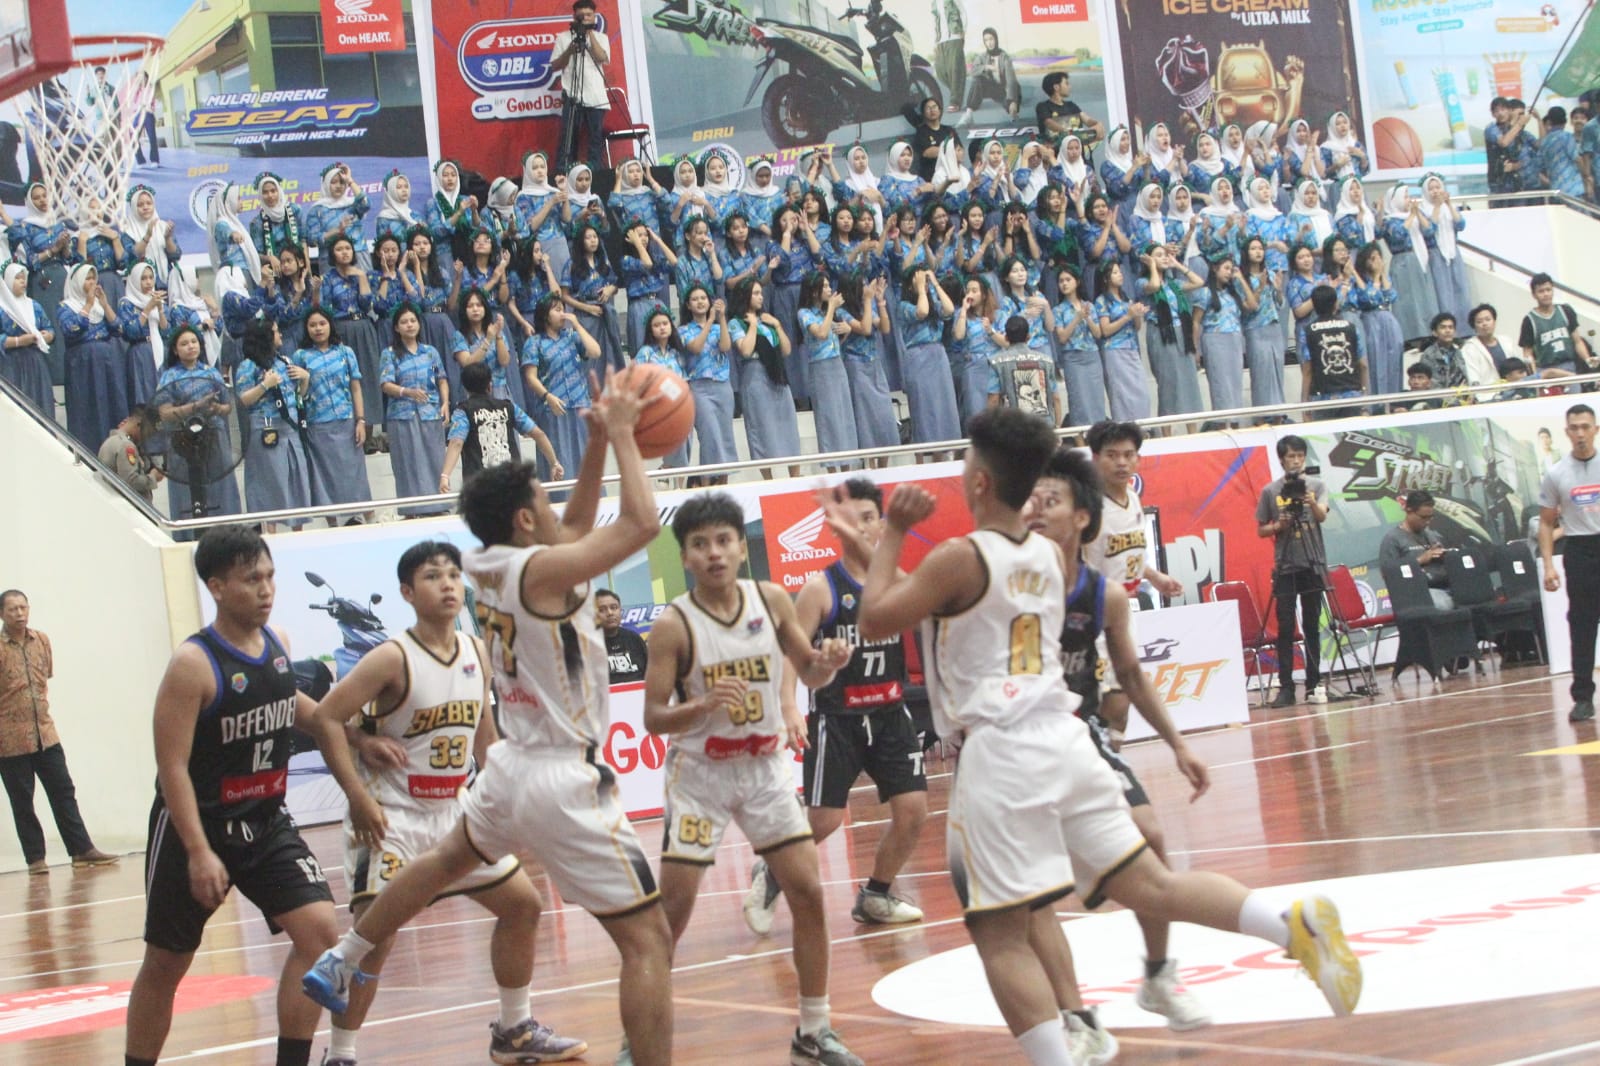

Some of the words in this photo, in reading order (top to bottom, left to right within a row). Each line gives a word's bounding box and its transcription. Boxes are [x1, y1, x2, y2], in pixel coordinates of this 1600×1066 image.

[336, 13, 390, 24] HONDA
[1242, 11, 1279, 26] ULTRA
[1281, 9, 1311, 24] MILK
[338, 33, 358, 45] One
[358, 31, 392, 44] HEART.
[498, 33, 561, 49] HOND
[499, 56, 535, 76] DBL
[207, 93, 258, 107] MULAI
[260, 88, 329, 103] BARENG
[233, 134, 267, 145] HIDUP
[692, 126, 735, 143] BARU
[188, 163, 229, 178] BARU
[1347, 450, 1450, 494] STREET
[780, 547, 837, 563] HONDA
[783, 573, 804, 587] One
[861, 651, 886, 677] 77
[252, 738, 274, 773] 12
[430, 735, 469, 769] 33
[679, 814, 713, 848] 69
[296, 855, 327, 884] 12
